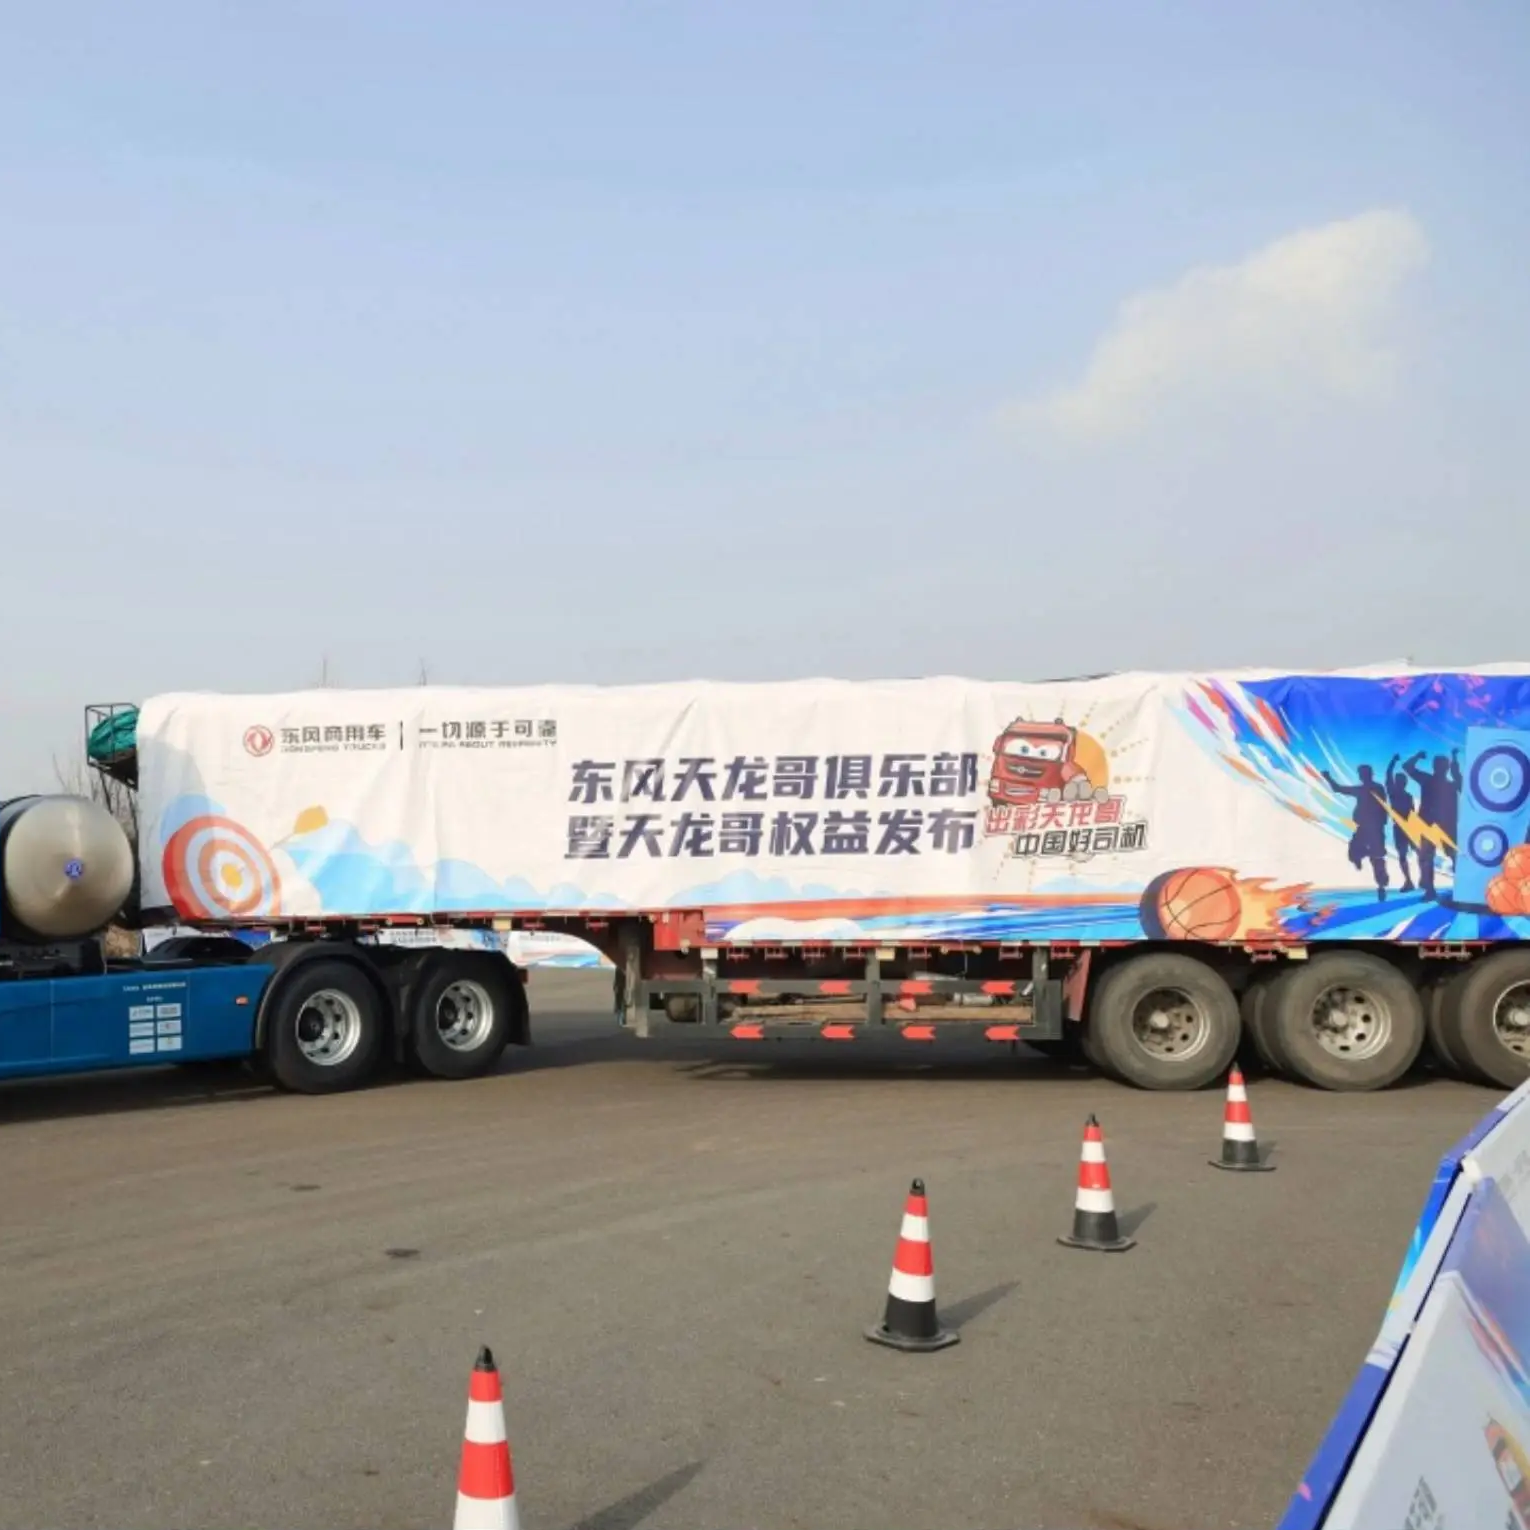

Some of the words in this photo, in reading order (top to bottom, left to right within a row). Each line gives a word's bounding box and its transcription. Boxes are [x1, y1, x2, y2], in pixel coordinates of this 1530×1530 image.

[280, 723, 386, 745] 东风商用车
[419, 719, 558, 740] 一切源于可靠
[568, 752, 979, 803] 东风天龙哥俱乐部
[564, 807, 978, 859] 暨天龙哥权益发布
[1014, 823, 1147, 855] 中国好司机
